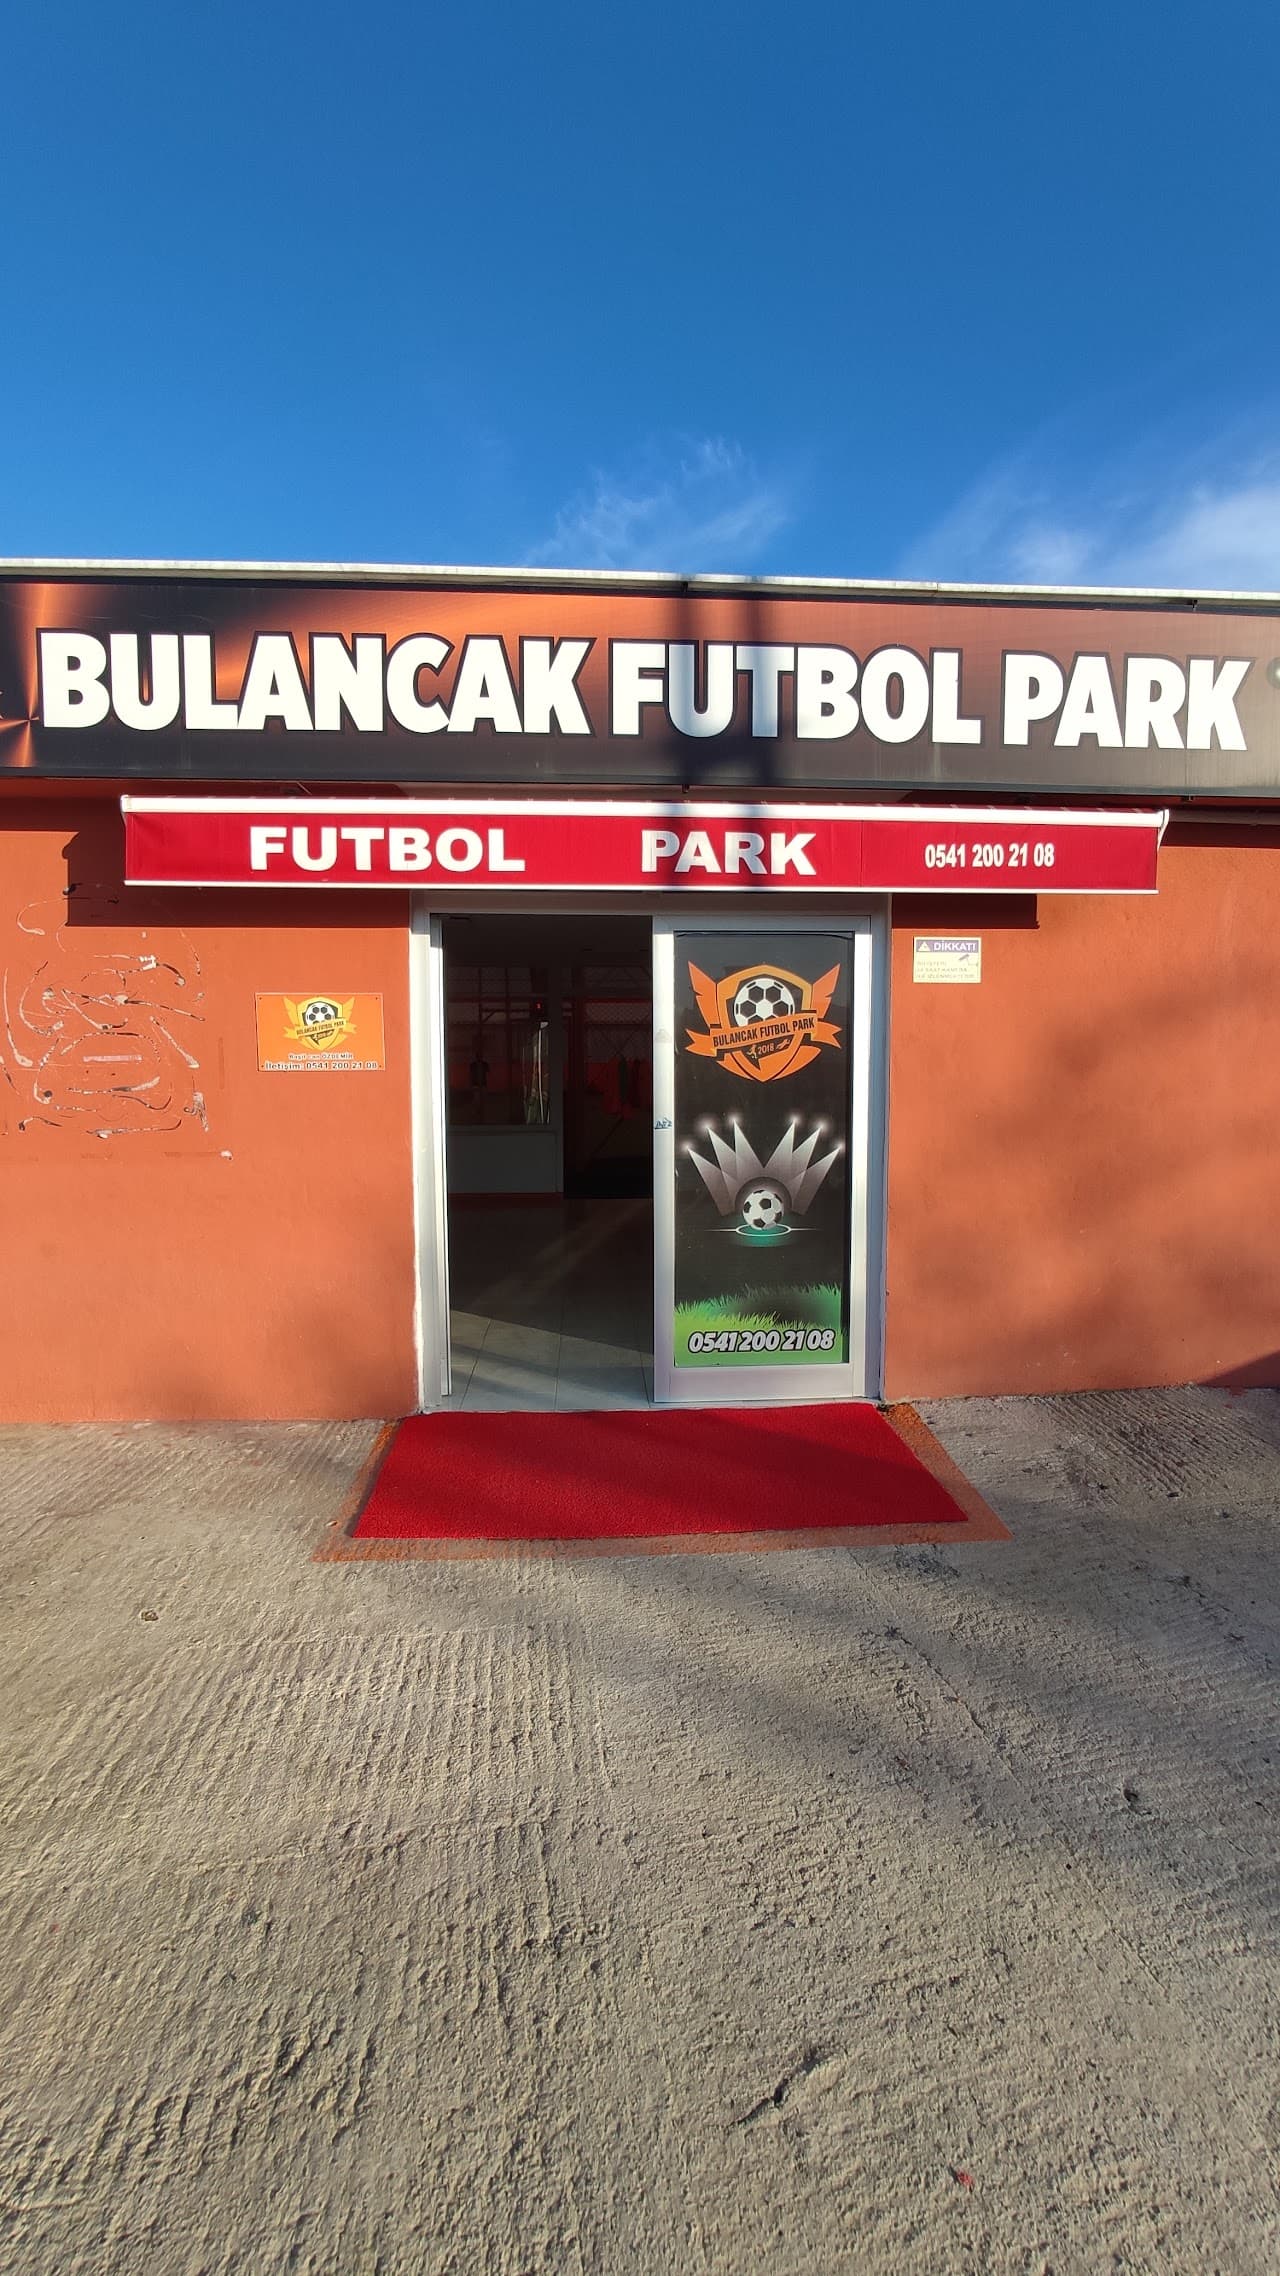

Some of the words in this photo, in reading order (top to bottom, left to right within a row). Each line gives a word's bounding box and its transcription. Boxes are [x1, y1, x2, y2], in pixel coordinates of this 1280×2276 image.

[39, 631, 591, 735] BULANCAK
[612, 641, 982, 745] FUTBOL
[1002, 652, 1255, 752] PARK
[249, 826, 526, 873] FUTBOL
[641, 829, 817, 876] PARK
[924, 843, 966, 868] 0541
[971, 843, 1005, 868] 200
[1007, 842, 1029, 867] 21
[1033, 842, 1055, 868] 08
[712, 1026, 758, 1048] BULANCAK
[759, 1020, 791, 1038] FUTBOL
[792, 1017, 815, 1032] PARK
[757, 1042, 775, 1055] 2018
[306, 1061, 329, 1069] 0541
[332, 1061, 349, 1069] 200
[351, 1061, 362, 1069] 21
[366, 1061, 378, 1069] 08
[689, 1331, 738, 1353] 0541
[738, 1330, 780, 1351] 200
[781, 1329, 805, 1350] 21
[806, 1329, 835, 1351] 08
